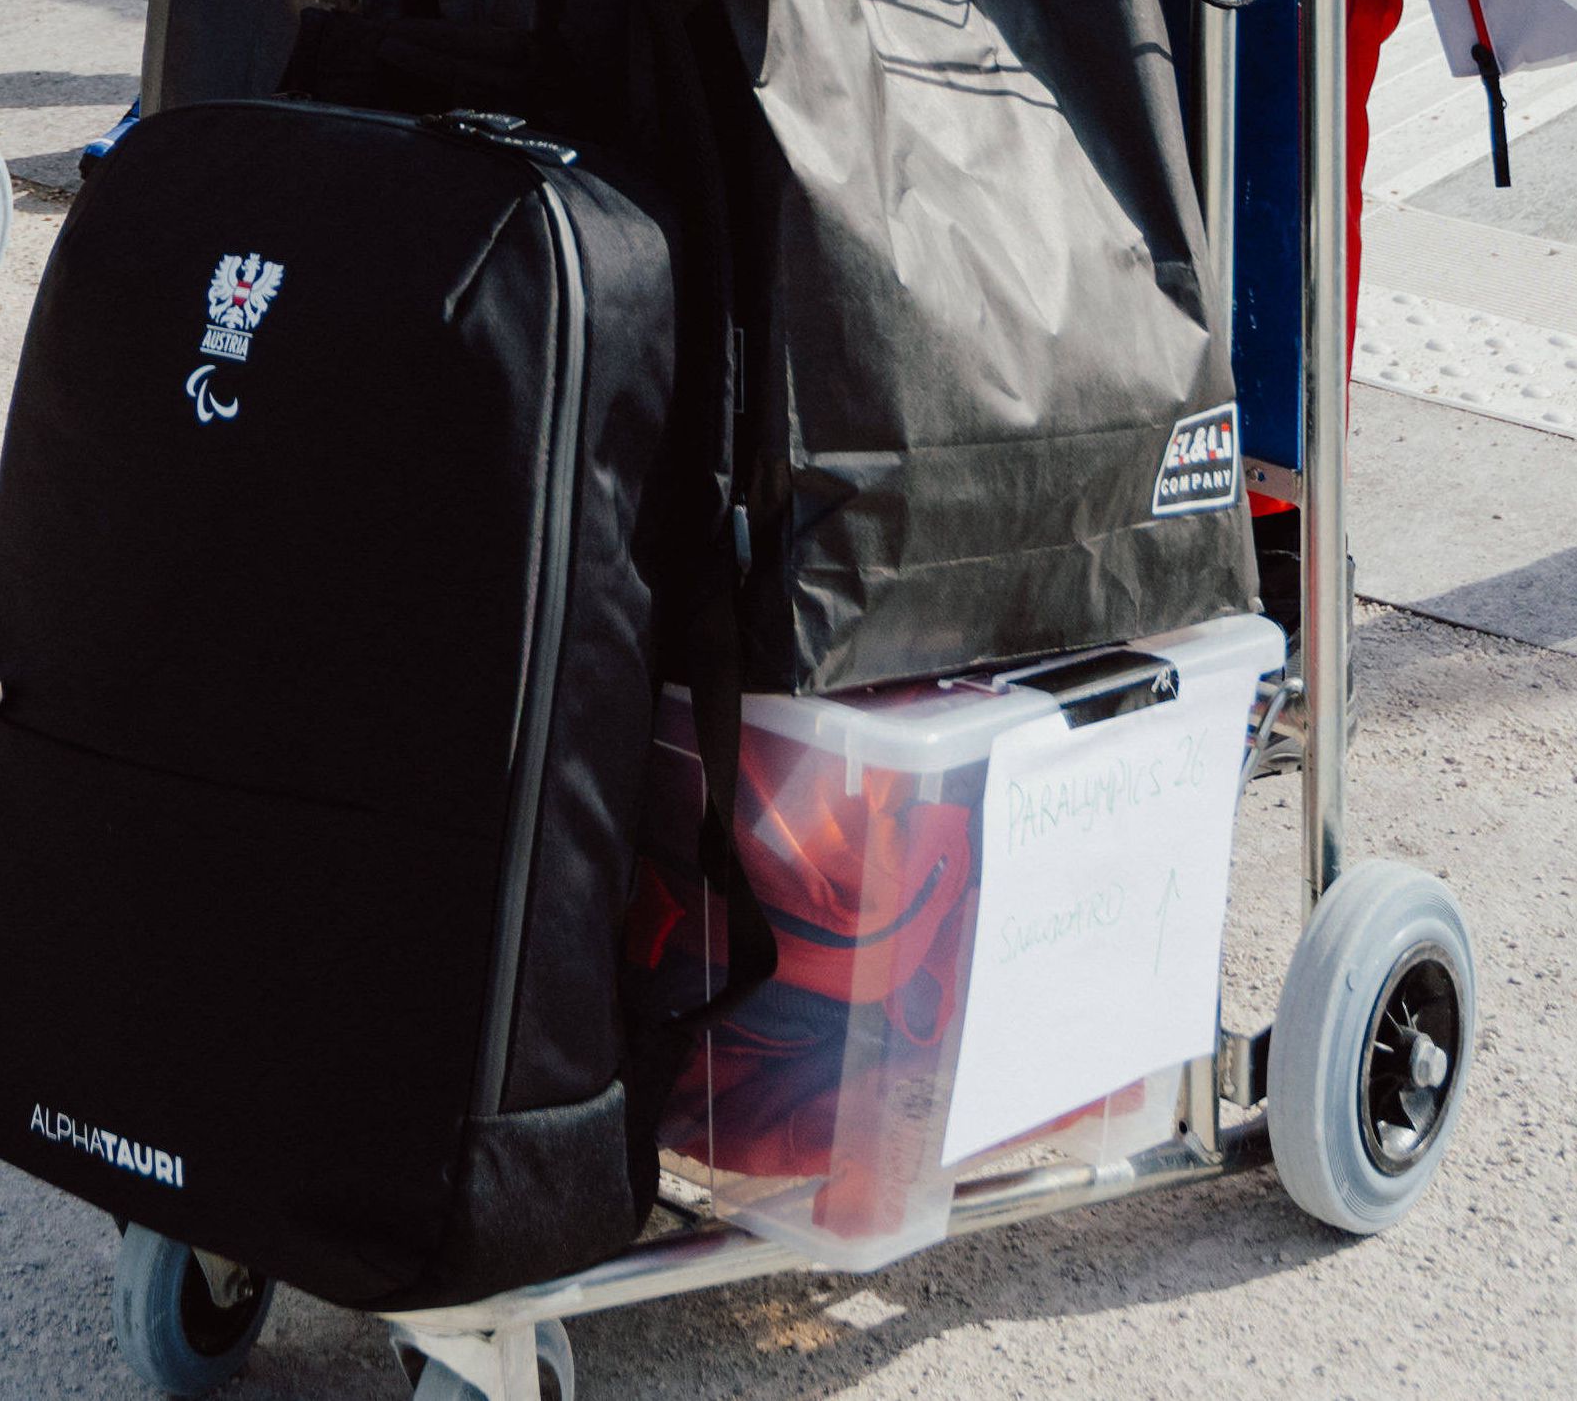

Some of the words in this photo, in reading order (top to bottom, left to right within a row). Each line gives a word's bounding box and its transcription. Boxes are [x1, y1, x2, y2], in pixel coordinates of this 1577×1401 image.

[201, 329, 249, 355] AUSTRIA
[1160, 469, 1232, 497] COMPANY
[30, 1102, 183, 1188] ALPHATAURI
